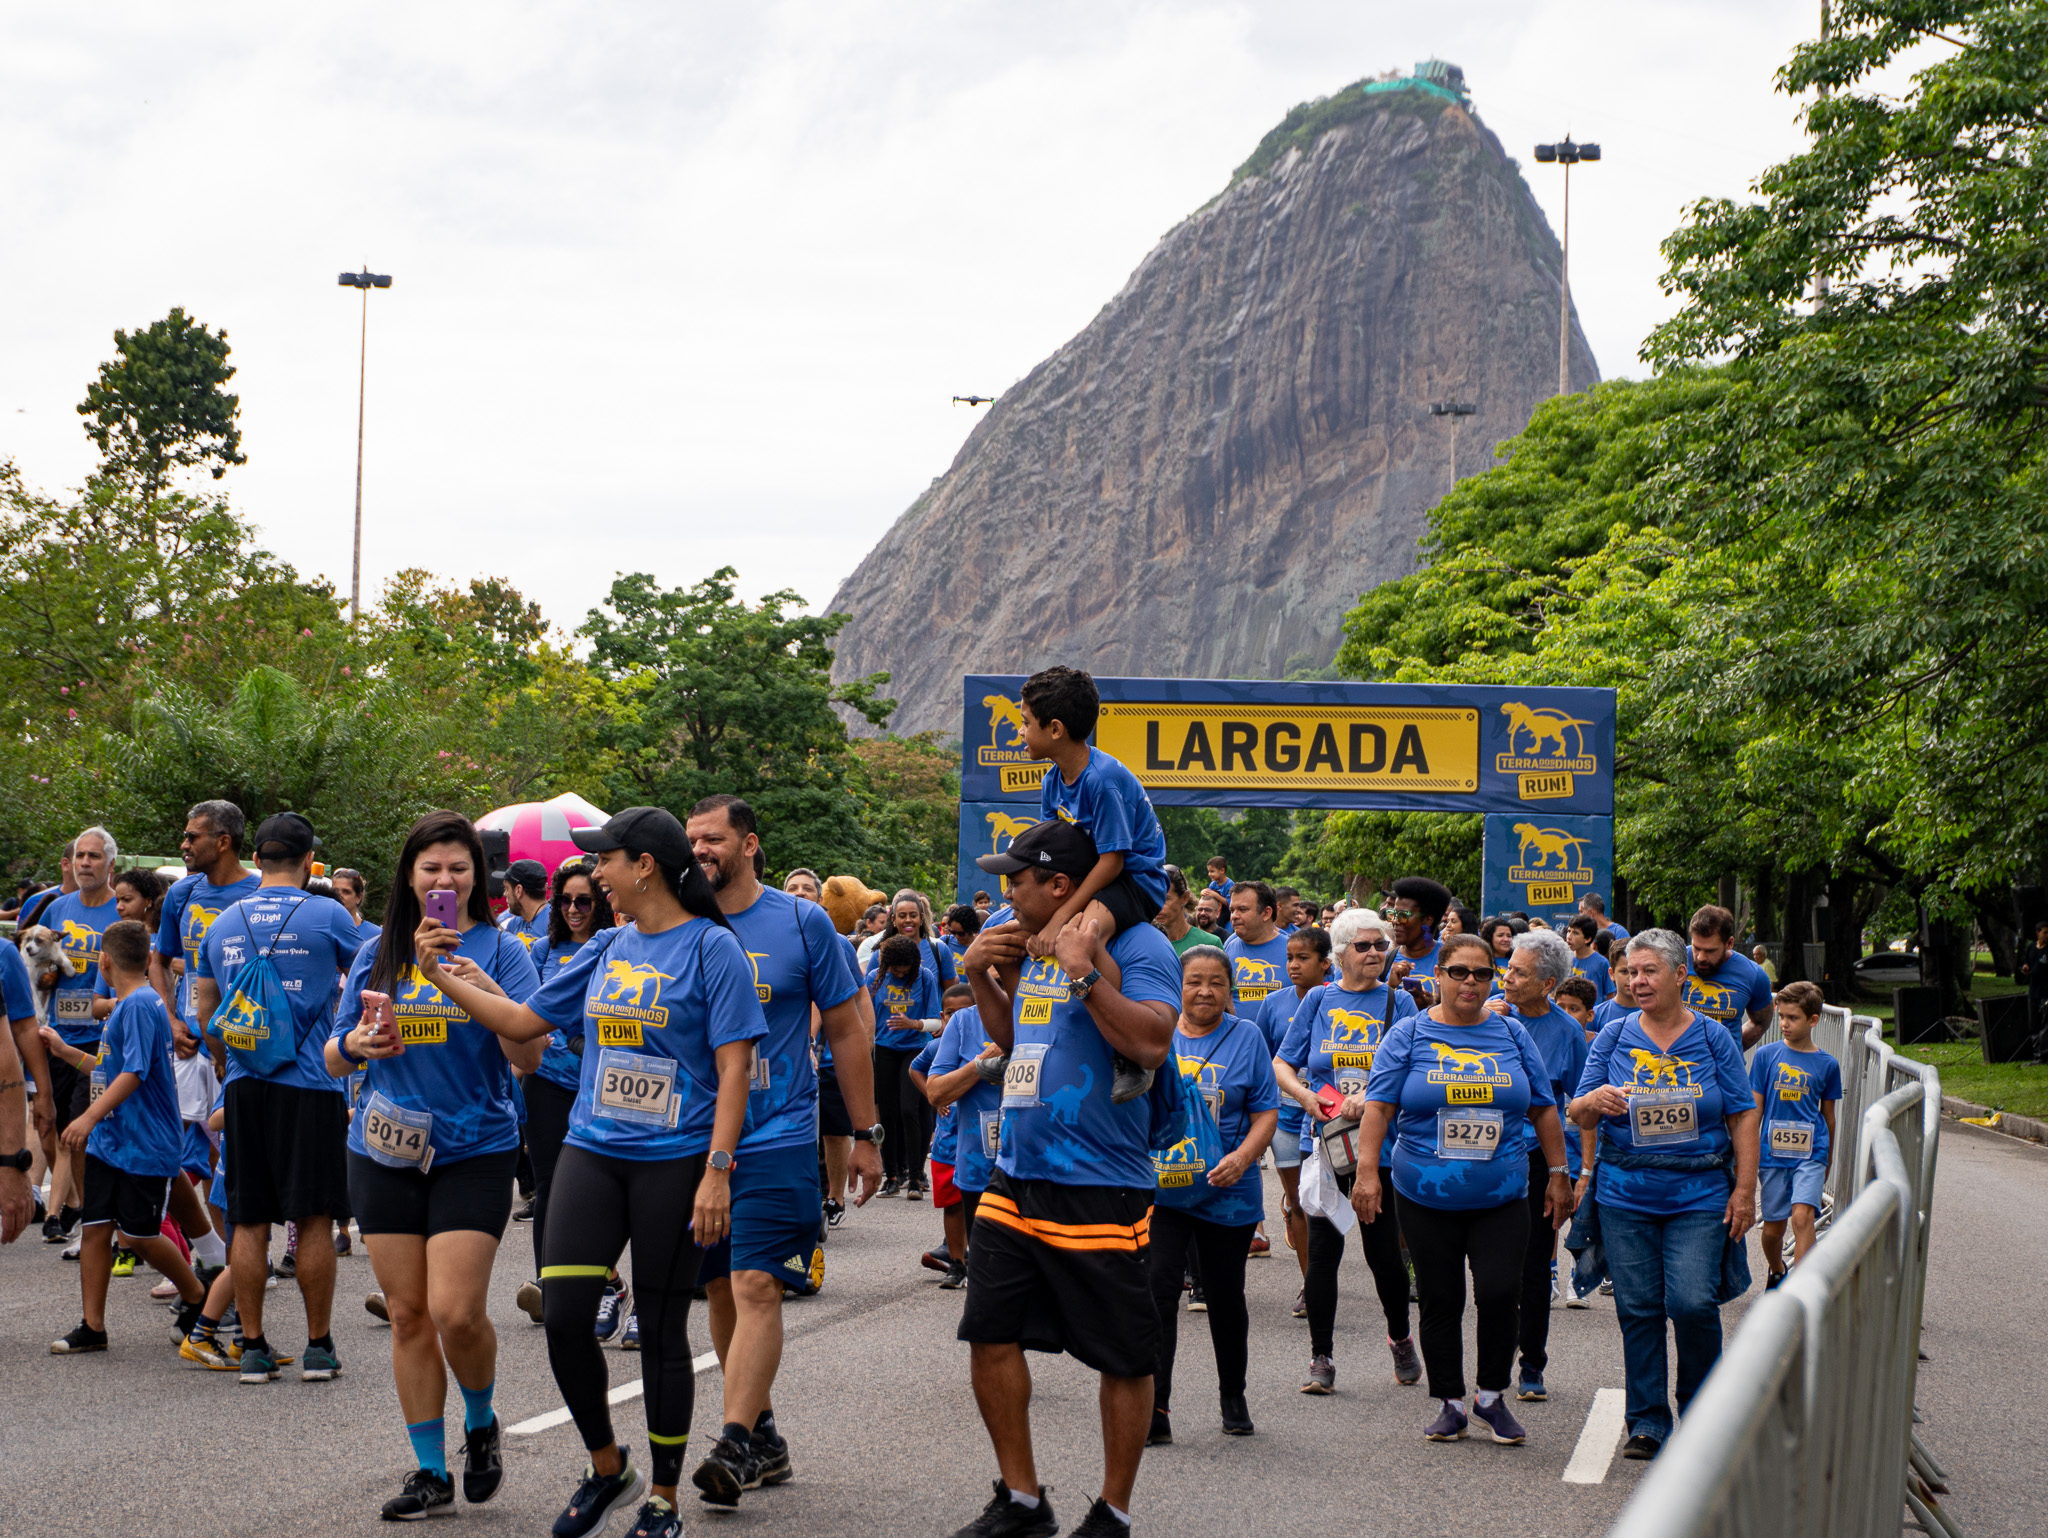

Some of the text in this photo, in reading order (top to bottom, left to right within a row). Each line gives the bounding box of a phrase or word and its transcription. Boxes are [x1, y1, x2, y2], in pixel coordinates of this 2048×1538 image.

[1146, 720, 1430, 775] LARGADA
[982, 750, 1021, 762] TERRA
[1501, 757, 1592, 770] TERRA DOS DINOS
[1525, 776, 1567, 793] RUN!
[1512, 869, 1545, 880] TERRA
[1558, 870, 1590, 881] DINOS
[1532, 885, 1568, 900] RUN!
[261, 914, 282, 923] Light
[289, 947, 310, 955] Pedro
[1019, 981, 1039, 994] TERRA
[1045, 986, 1068, 998] DINOS
[1242, 990, 1265, 999] RUN!
[59, 1001, 90, 1012] 3857
[393, 1004, 467, 1018] RRA DOS DINOS
[589, 1001, 664, 1023] TERRA DOS DINOS
[1023, 1003, 1049, 1018] RUN!
[219, 1018, 239, 1031] ERRA
[401, 1022, 441, 1037] RUN!
[602, 1024, 638, 1040] RUN!
[226, 1034, 252, 1047] RUN!
[1323, 1042, 1349, 1050] TERRA
[1337, 1055, 1369, 1067] RUN!
[1006, 1064, 1036, 1084] 008
[1432, 1073, 1464, 1082] TERRA
[1477, 1075, 1509, 1084] DINOS
[605, 1073, 666, 1100] 3007
[1451, 1087, 1488, 1100] RUN!
[1782, 1091, 1799, 1099] RUN!
[1640, 1107, 1690, 1127] 3269
[369, 1115, 421, 1150] 3014
[1447, 1123, 1498, 1141] 3279
[1773, 1131, 1809, 1145] 4557
[1180, 1162, 1204, 1170] DINOS
[1162, 1173, 1189, 1185] RUN!
[784, 1261, 806, 1273] adidas
